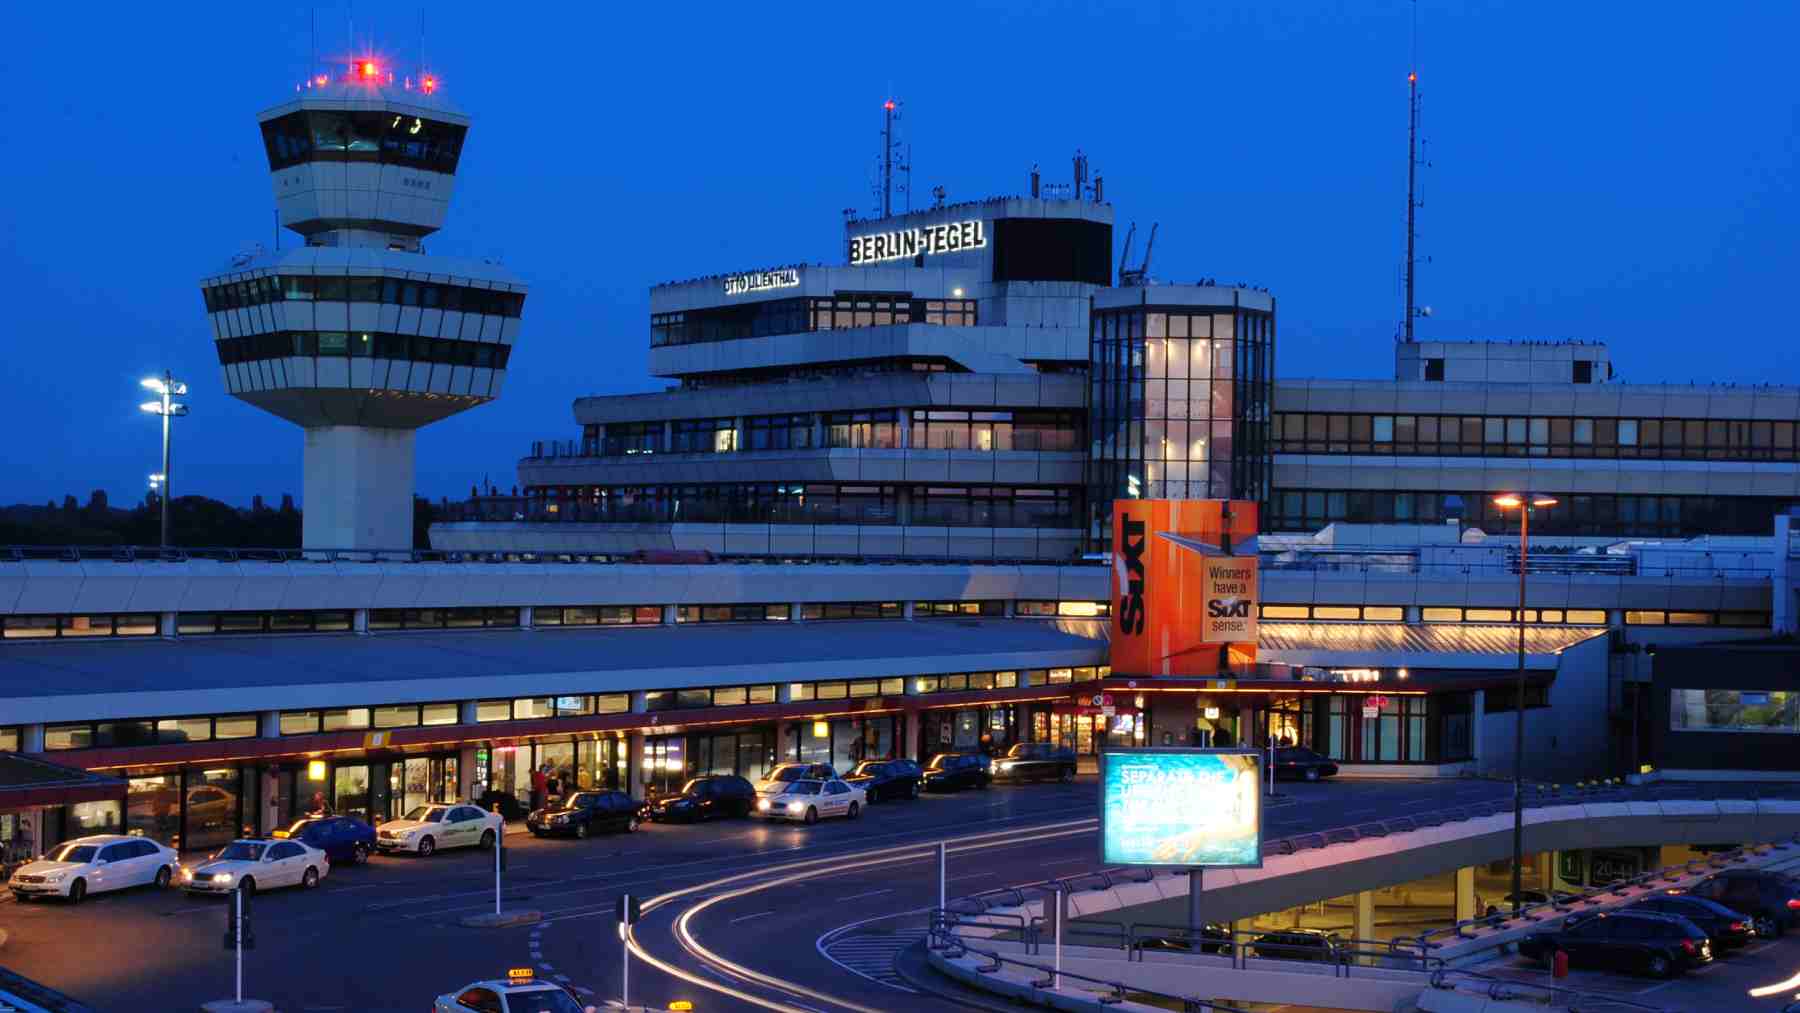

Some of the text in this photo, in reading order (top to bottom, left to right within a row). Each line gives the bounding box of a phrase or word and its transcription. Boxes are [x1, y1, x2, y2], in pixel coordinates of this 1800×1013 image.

[849, 220, 985, 264] BERLIN-TEGEL
[723, 270, 799, 294] OTTO LILIENTHAL
[1120, 513, 1145, 636] SIXT
[1209, 567, 1251, 579] Winners
[1213, 581, 1247, 593] have a
[1208, 599, 1251, 618] SIXT
